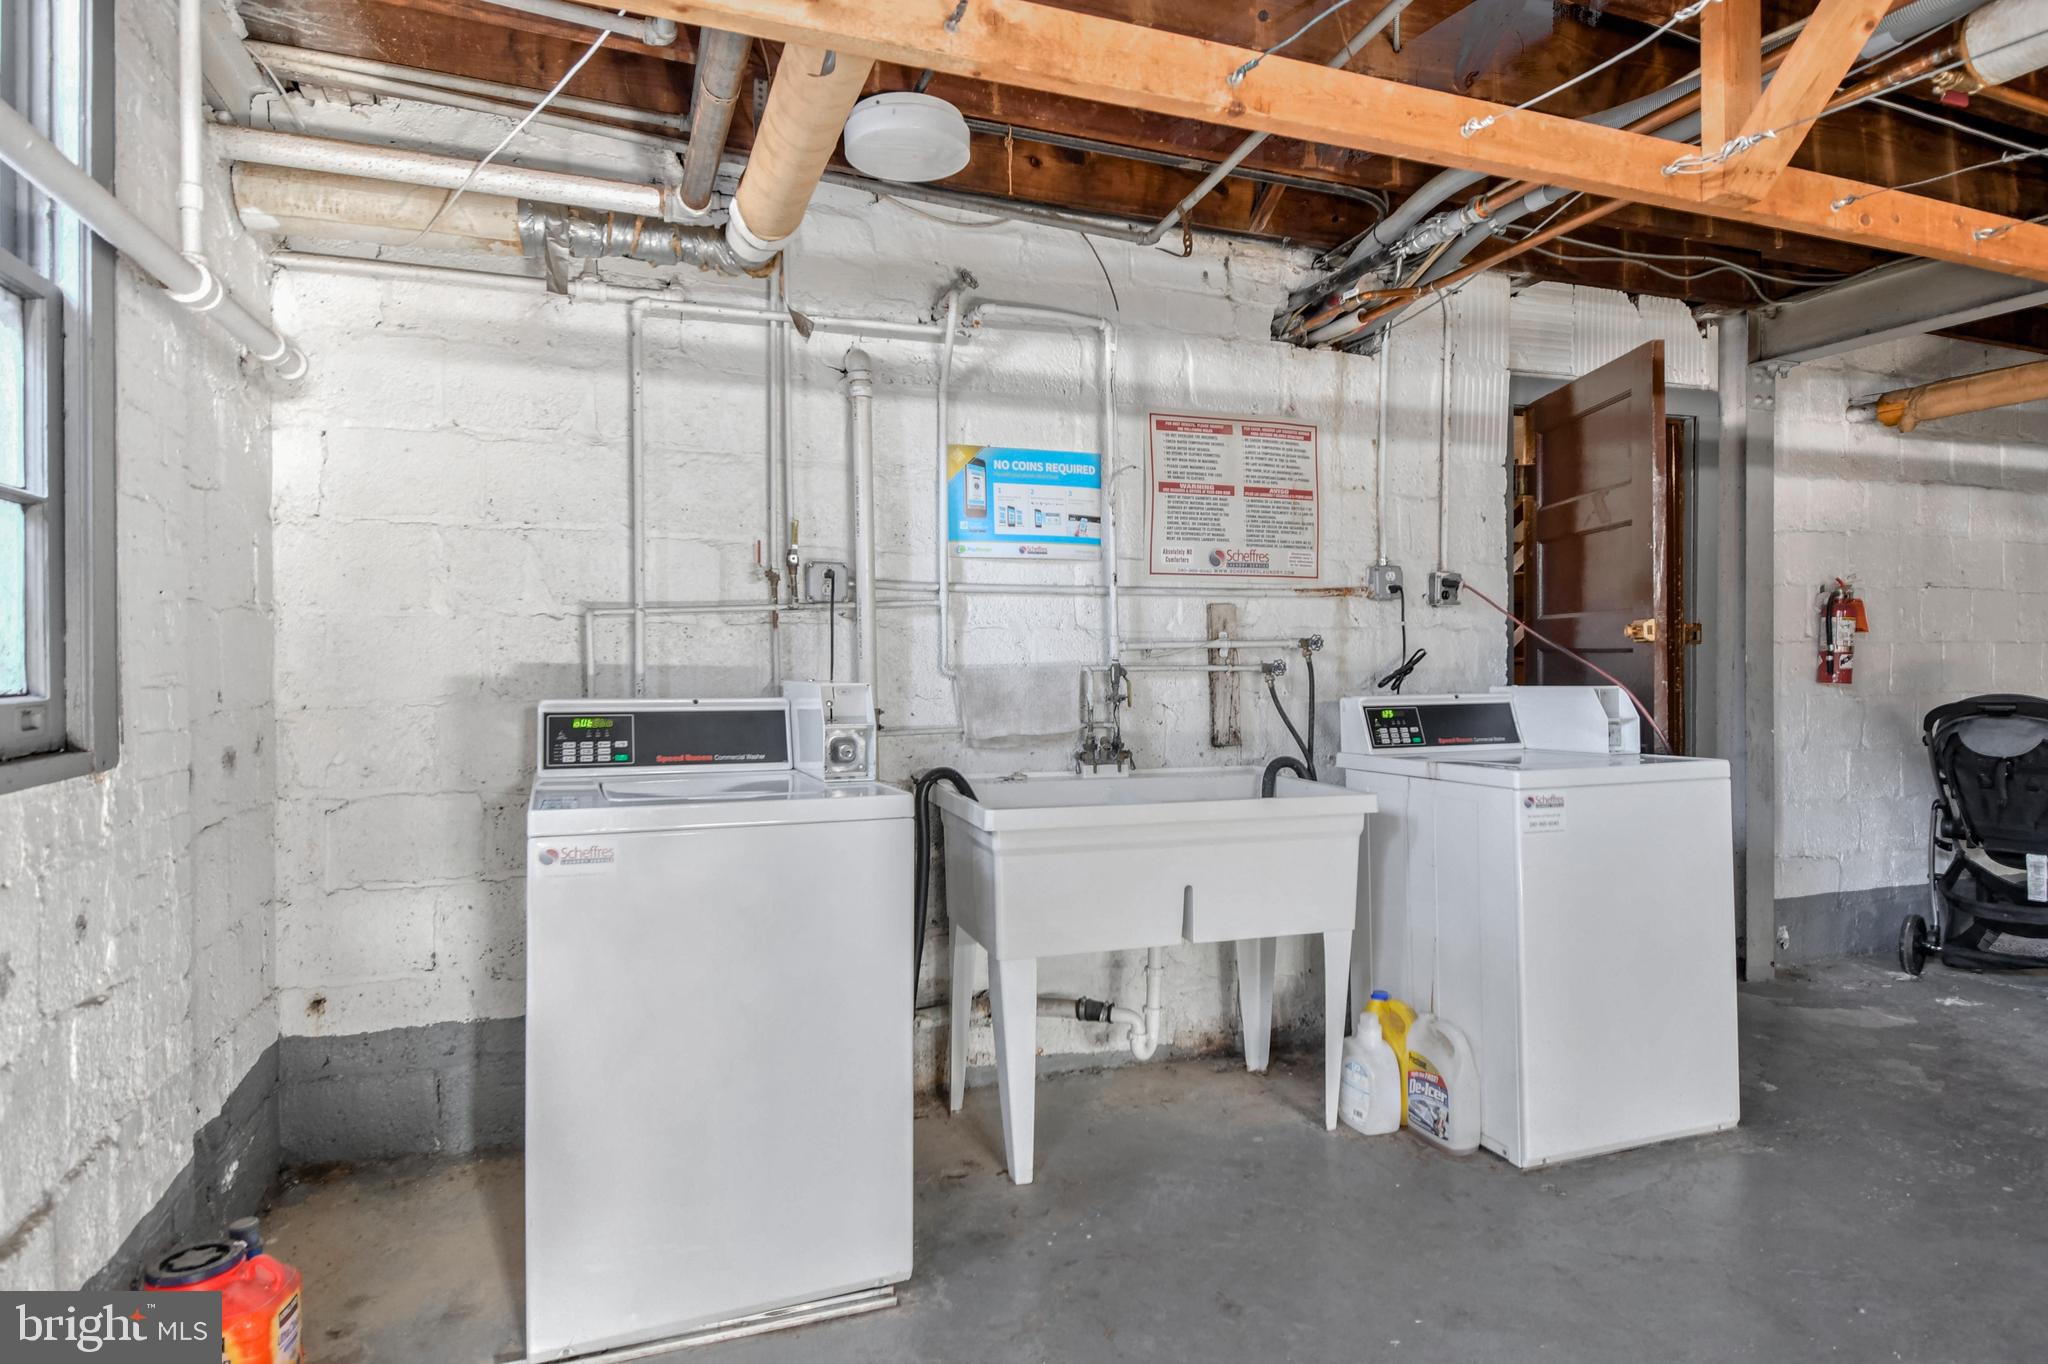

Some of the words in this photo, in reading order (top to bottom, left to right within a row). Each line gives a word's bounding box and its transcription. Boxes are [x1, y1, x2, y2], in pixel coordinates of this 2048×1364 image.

[993, 459, 1010, 470] NO
[1012, 461, 1043, 472] COINS
[1046, 463, 1095, 475] REQUIRED
[1227, 549, 1269, 562] Scheffres
[714, 754, 745, 762] Commercial
[560, 846, 614, 859] Scheffres
